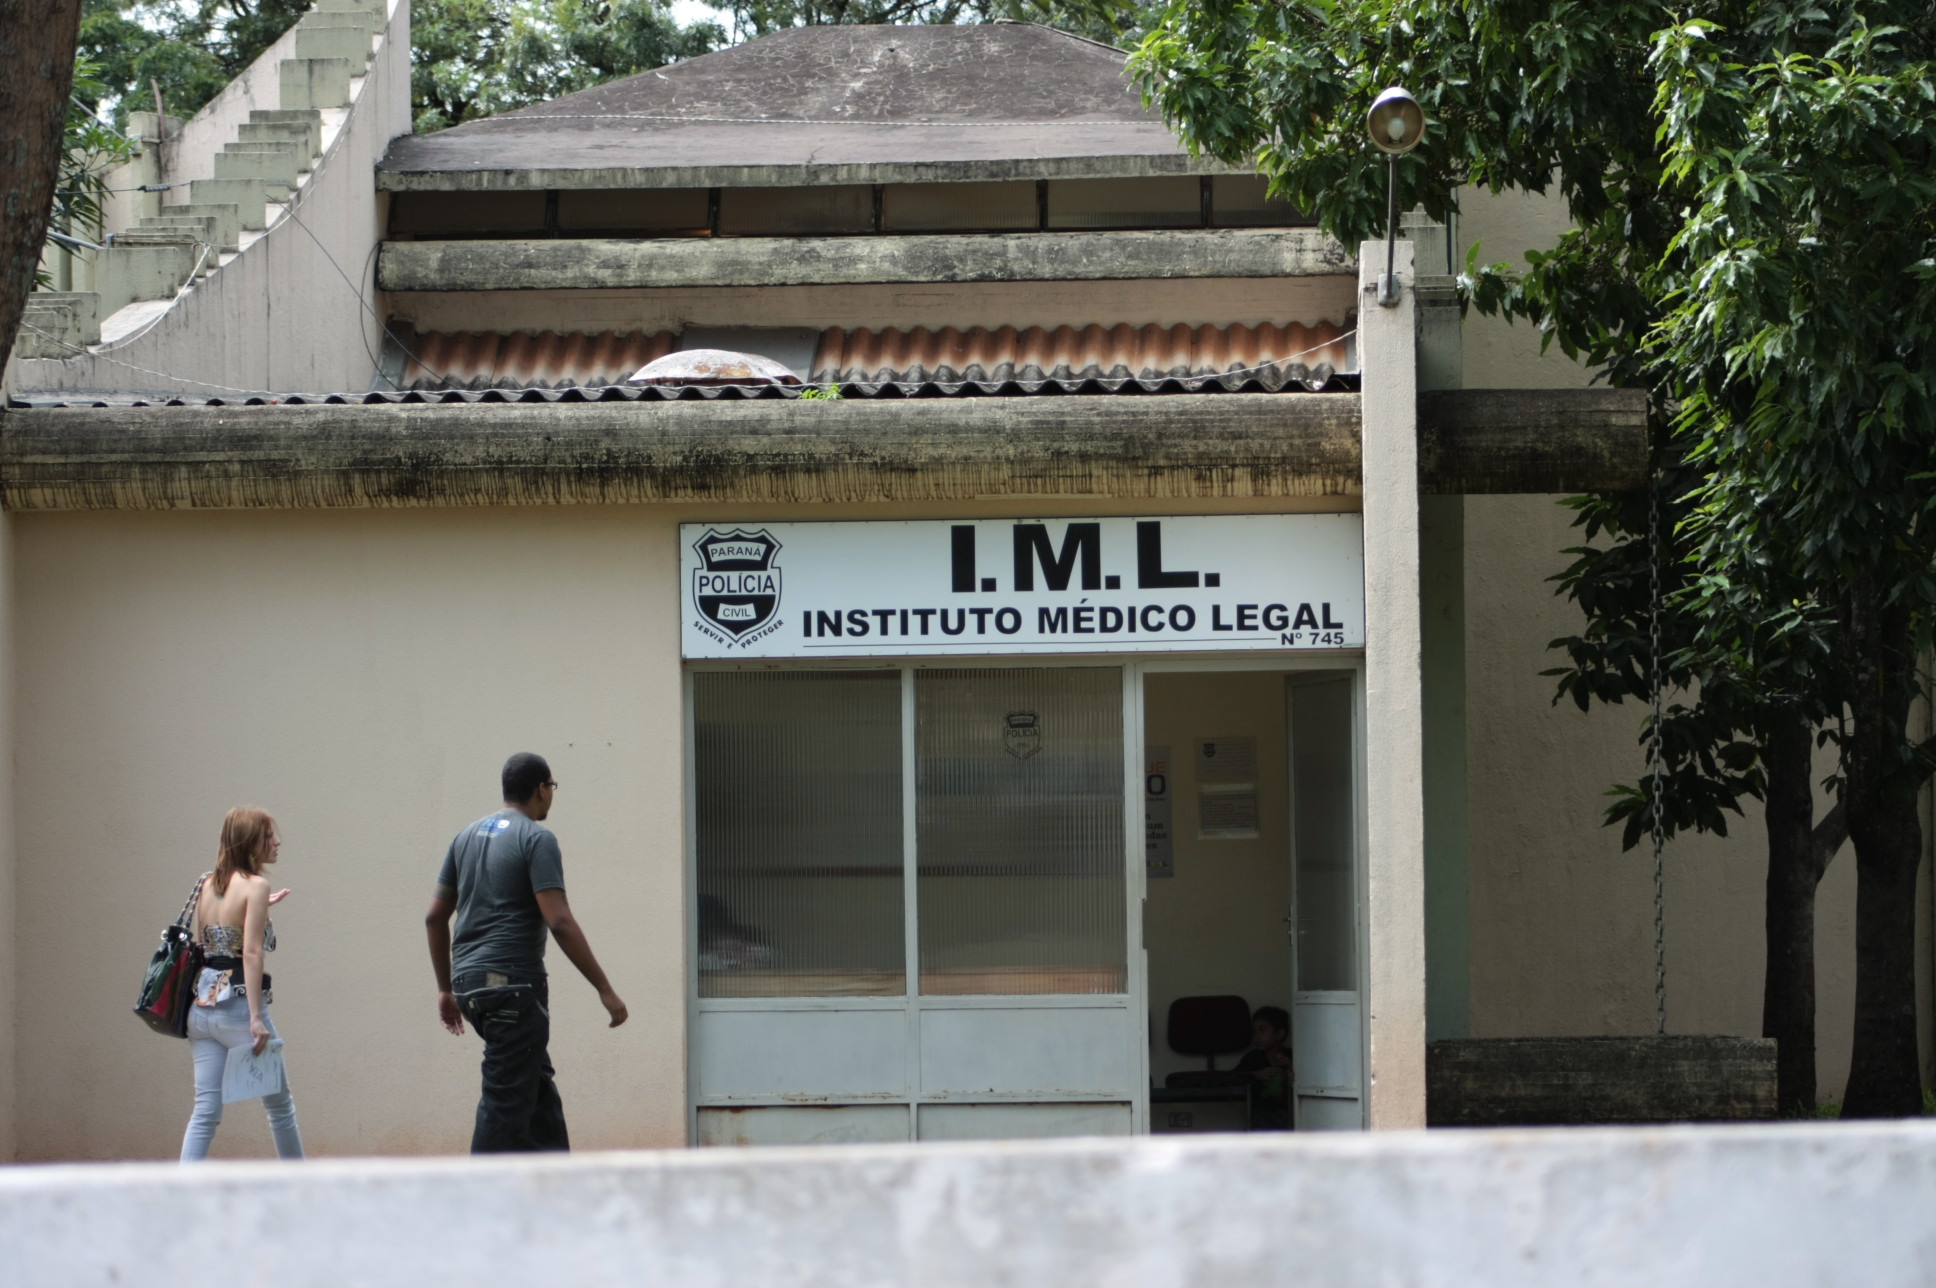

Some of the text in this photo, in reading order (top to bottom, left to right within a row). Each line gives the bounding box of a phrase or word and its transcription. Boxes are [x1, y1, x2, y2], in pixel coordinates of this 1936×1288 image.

[710, 545, 762, 558] PARANÁ
[951, 521, 1220, 593] I.M.L.
[699, 572, 776, 594] POLÍCIA
[722, 608, 751, 618] CIVIL
[803, 598, 1344, 638] INSTITUTO MÉDICO LEGAL
[693, 620, 725, 644] SERVIR
[740, 619, 784, 649] PROTEGER
[1309, 631, 1344, 645] 745
